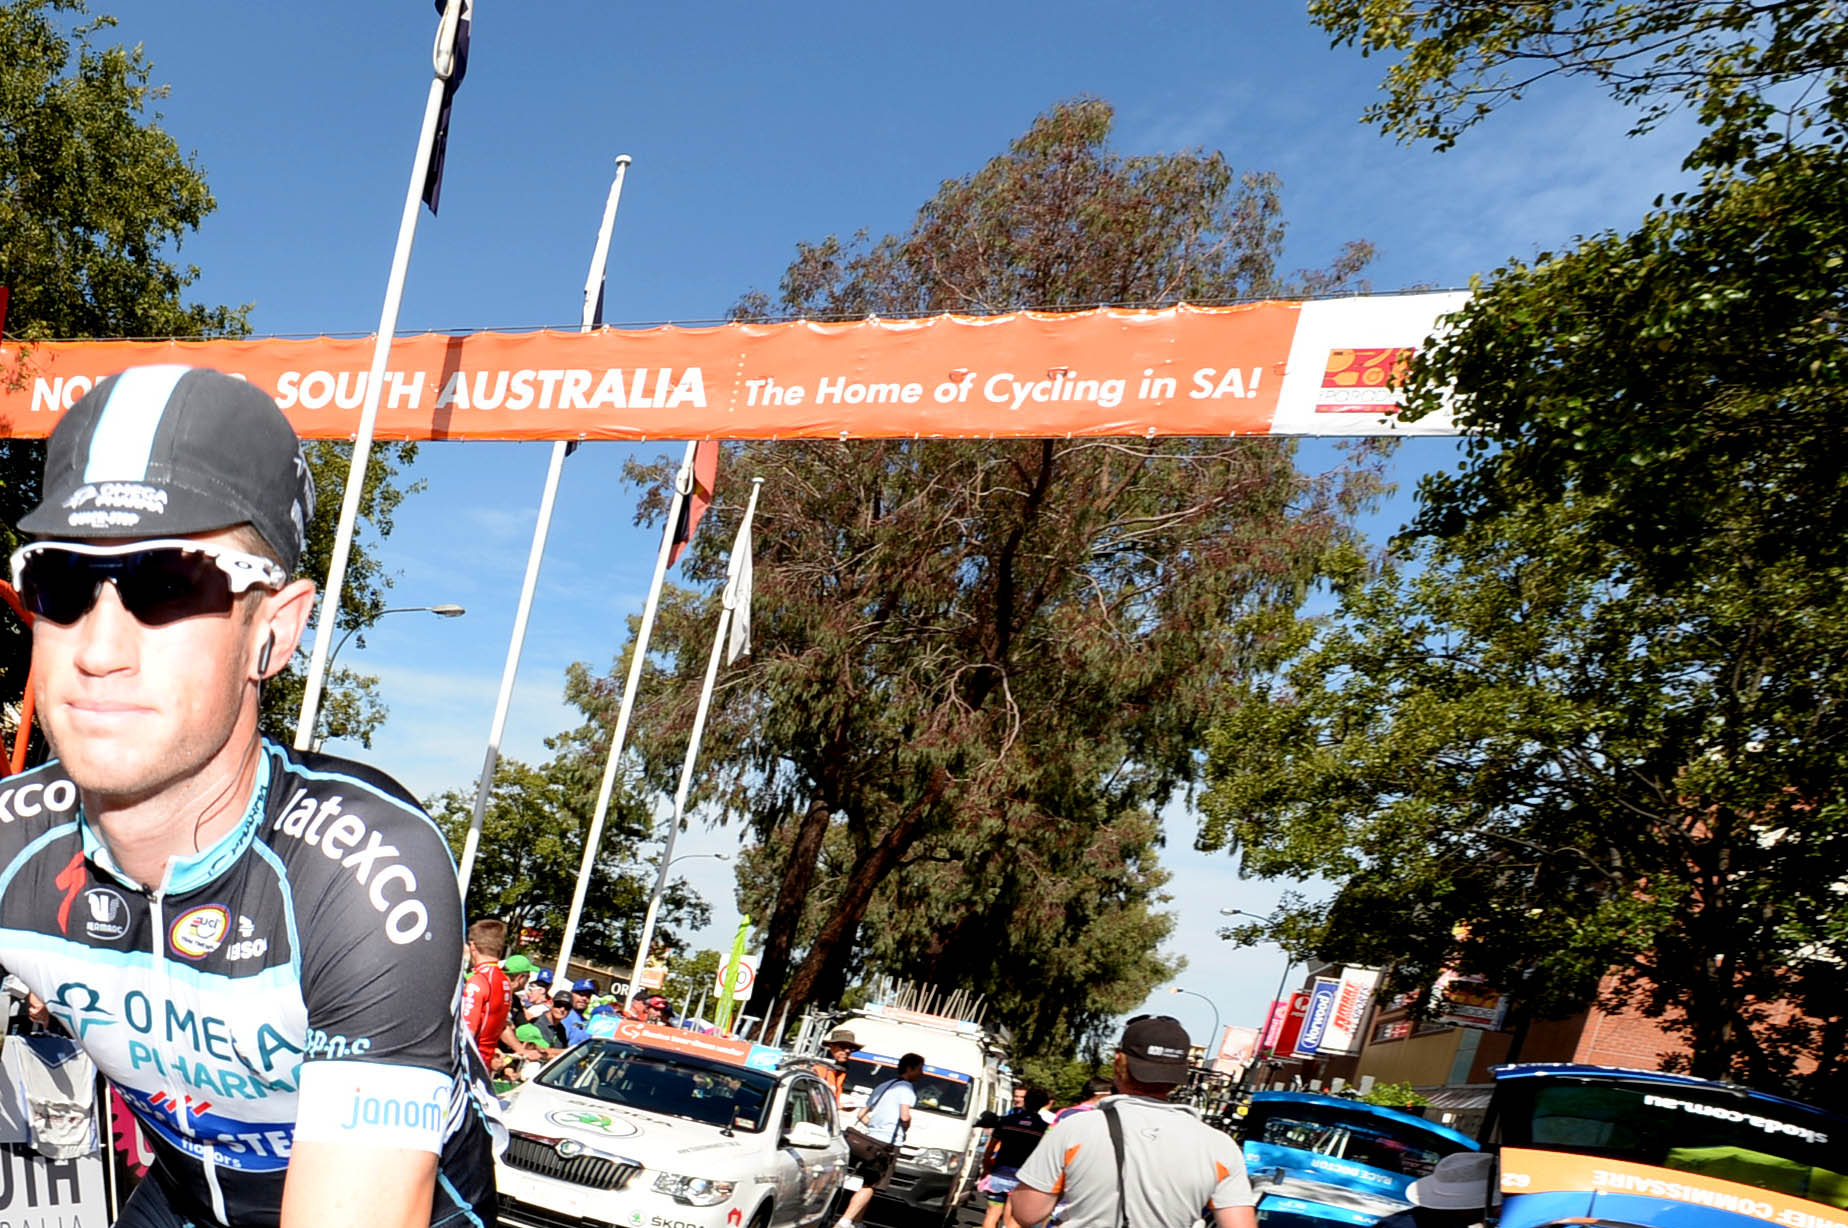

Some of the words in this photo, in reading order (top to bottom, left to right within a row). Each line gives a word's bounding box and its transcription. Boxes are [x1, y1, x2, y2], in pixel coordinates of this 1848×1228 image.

[275, 369, 416, 411] SOUTH
[433, 367, 709, 411] AUSTRALIA
[745, 376, 806, 407] The
[815, 373, 922, 405] Home
[933, 368, 977, 404] of
[983, 370, 1126, 411] Cycling
[1137, 368, 1177, 401] in
[1188, 366, 1261, 400] SA!
[272, 787, 430, 945] latexco
[1305, 994, 1331, 1044] Norwood
[1643, 1094, 1829, 1144] skoda.com.au
[1591, 1169, 1774, 1218] COMMISSAIRE
